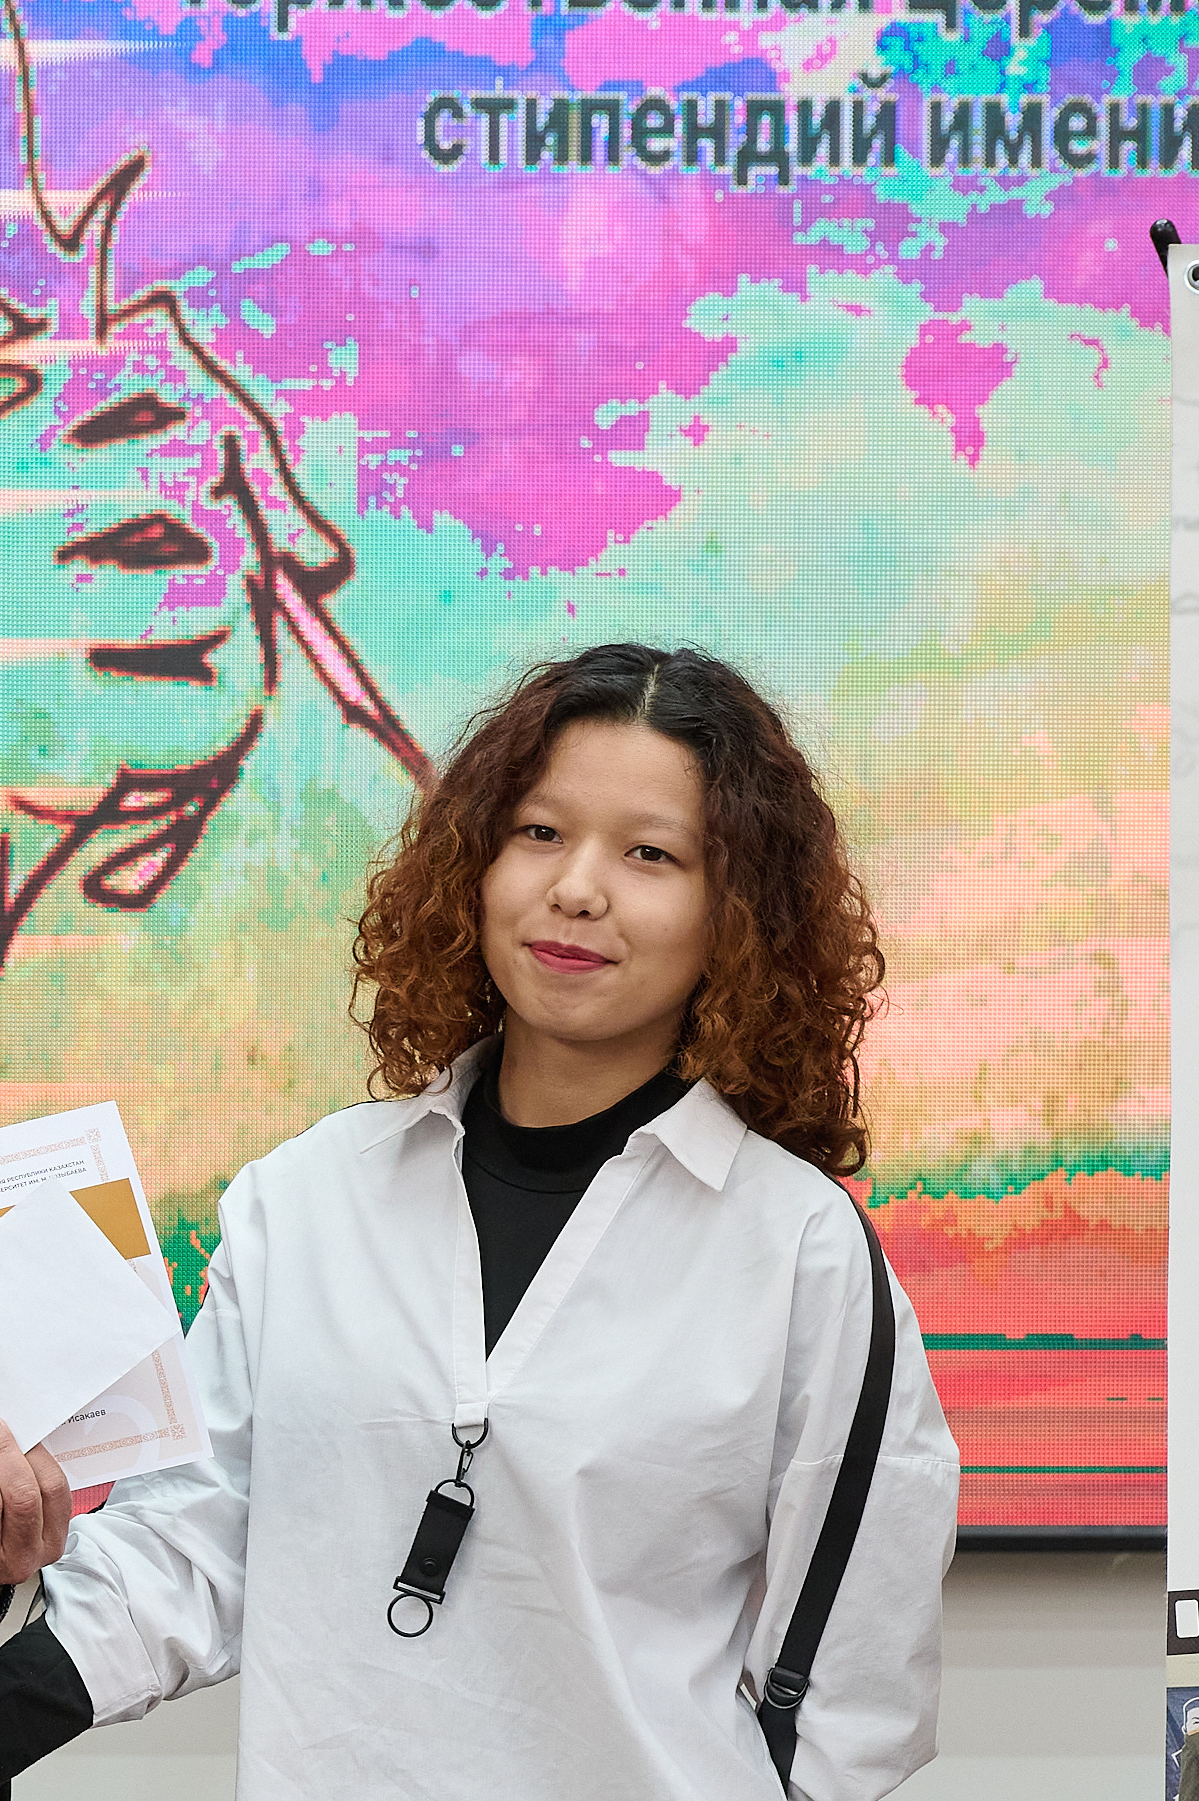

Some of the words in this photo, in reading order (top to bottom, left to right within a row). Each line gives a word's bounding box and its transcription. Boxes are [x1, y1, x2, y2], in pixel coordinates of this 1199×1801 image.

[424, 72, 896, 189] стипендий
[930, 96, 1199, 170] имени
[7, 1168, 49, 1183] РЕСПУБЛИКИ
[49, 1160, 85, 1172] КАЗАХСТАН
[67, 1409, 106, 1423] Исакаев
